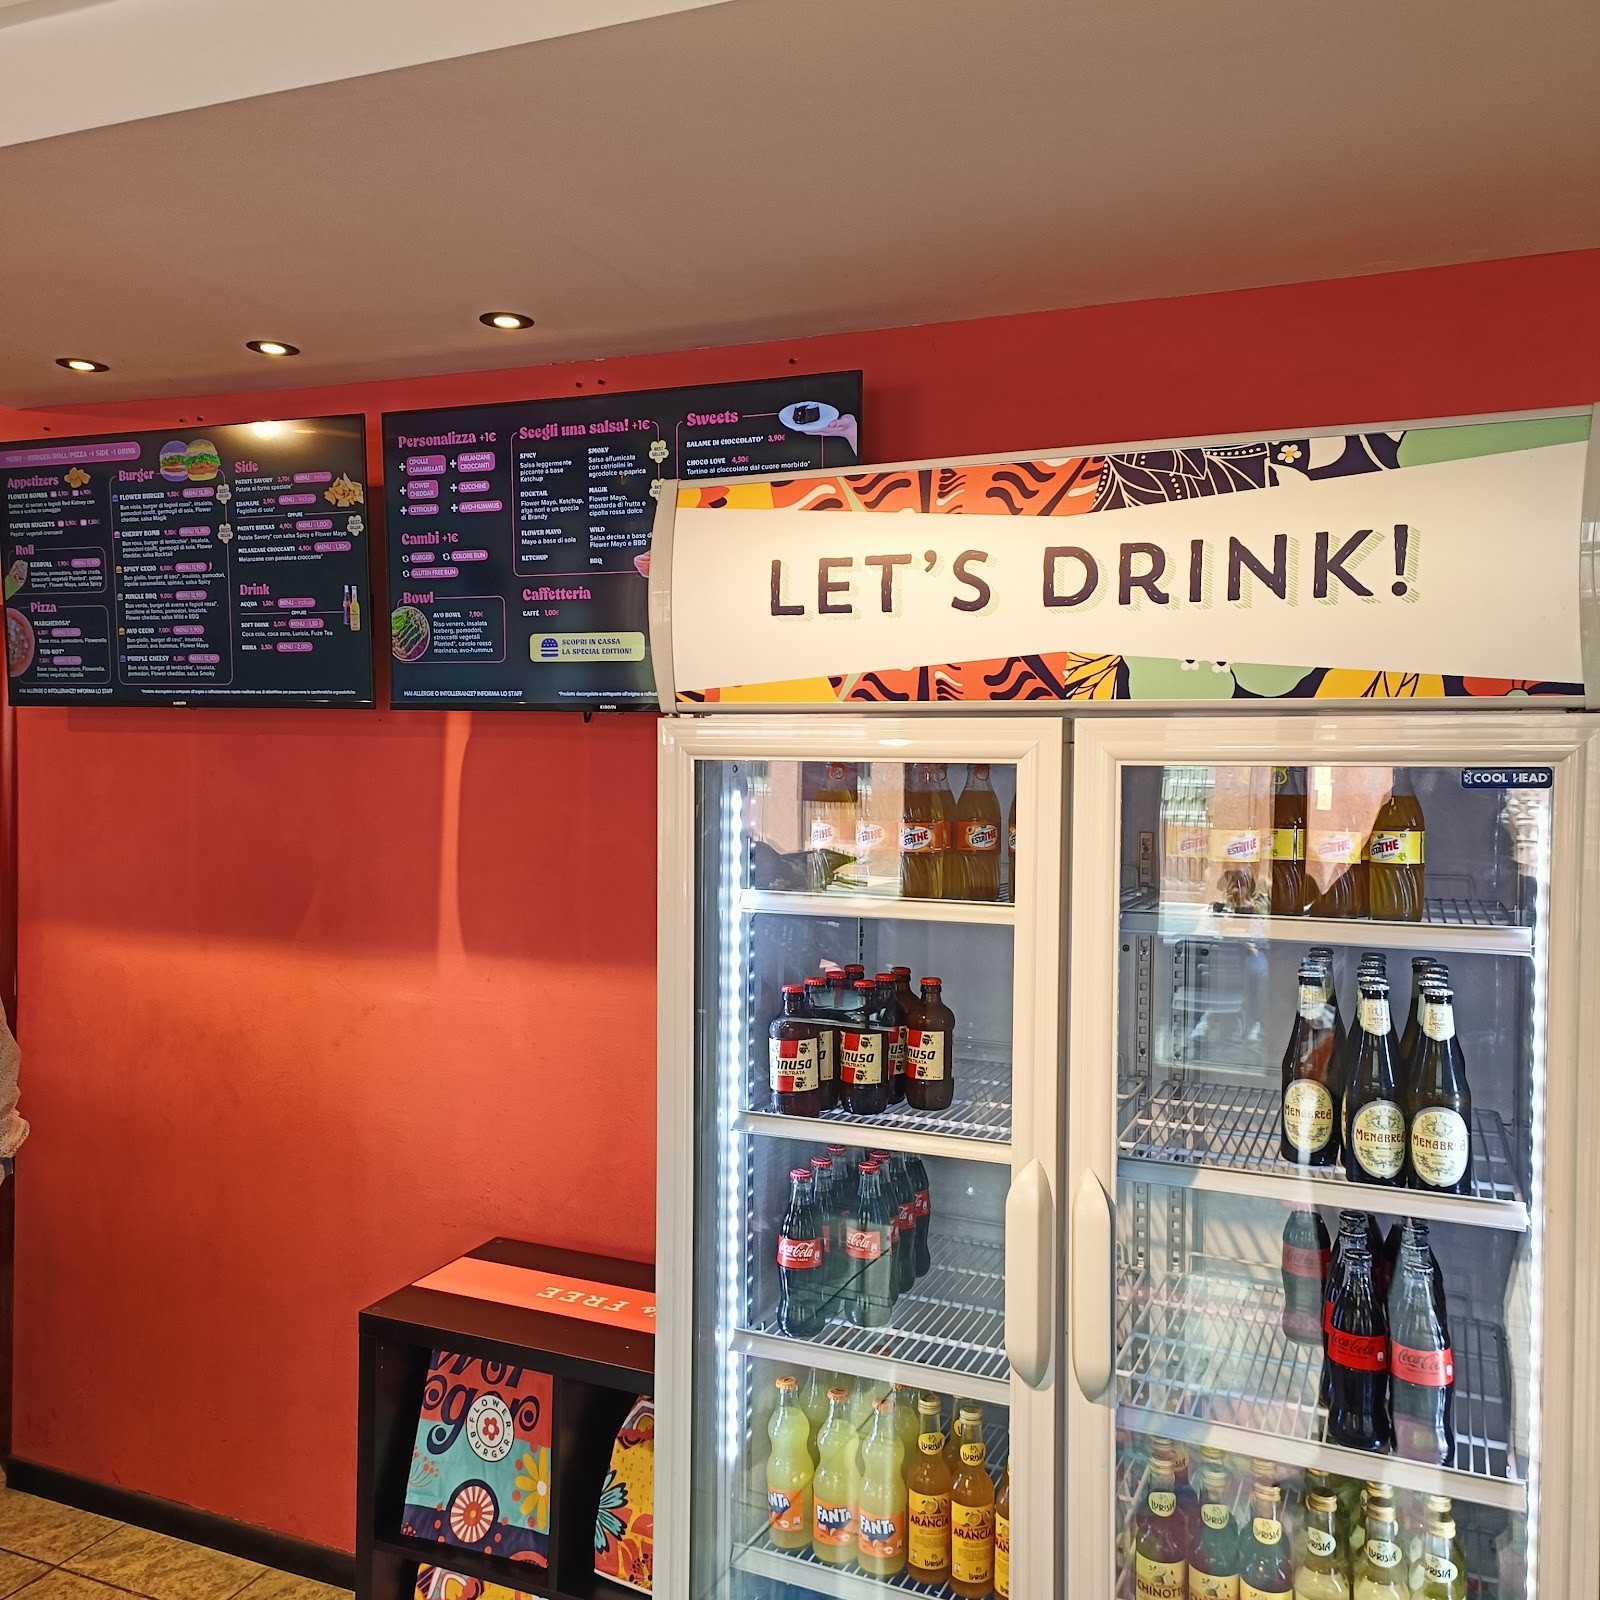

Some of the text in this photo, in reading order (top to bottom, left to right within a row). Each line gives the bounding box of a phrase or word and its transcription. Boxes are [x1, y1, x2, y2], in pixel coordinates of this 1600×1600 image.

[686, 410, 739, 427] Sweets
[519, 418, 650, 441] Scegli una salsa! +1€
[398, 431, 496, 448] Personalizza +1€
[768, 434, 786, 442] 3,90€
[235, 460, 258, 473] Side
[536, 460, 572, 468] leggermente
[686, 458, 709, 467] CHOCO
[717, 465, 748, 473] cioccolato
[119, 468, 154, 482] Burger
[624, 468, 646, 476] paprica
[8, 475, 59, 489] Appetizers
[559, 498, 584, 506] Ketchup,
[528, 513, 548, 521] Brandy
[589, 509, 608, 517] cipolla
[402, 531, 459, 545] Cambi +1€
[16, 544, 34, 555] Roll
[769, 523, 1410, 617] LET'S DRINK!
[240, 583, 270, 595] Drink
[523, 586, 592, 600] Caffetteria
[403, 591, 434, 604] Bowl
[30, 602, 57, 612] Pizza
[1473, 773, 1548, 783] COOL HEAD
[840, 1050, 874, 1063] nusa
[778, 1059, 812, 1070] nusa
[1412, 1134, 1466, 1151] MENABRA
[779, 1239, 815, 1258] Coca-Cola
[536, 1286, 630, 1312] FREE
[470, 1398, 511, 1428] FLOWER
[470, 1432, 510, 1458] BURGER
[768, 1491, 789, 1507] NTA
[816, 1504, 852, 1523] FANTA
[861, 1515, 894, 1535] FANTA
[911, 1514, 948, 1527] ARANCIA
[954, 1528, 993, 1540] ARANCIA
[1425, 1564, 1451, 1578] URISIA
[1137, 1579, 1182, 1598] CHINOTT
